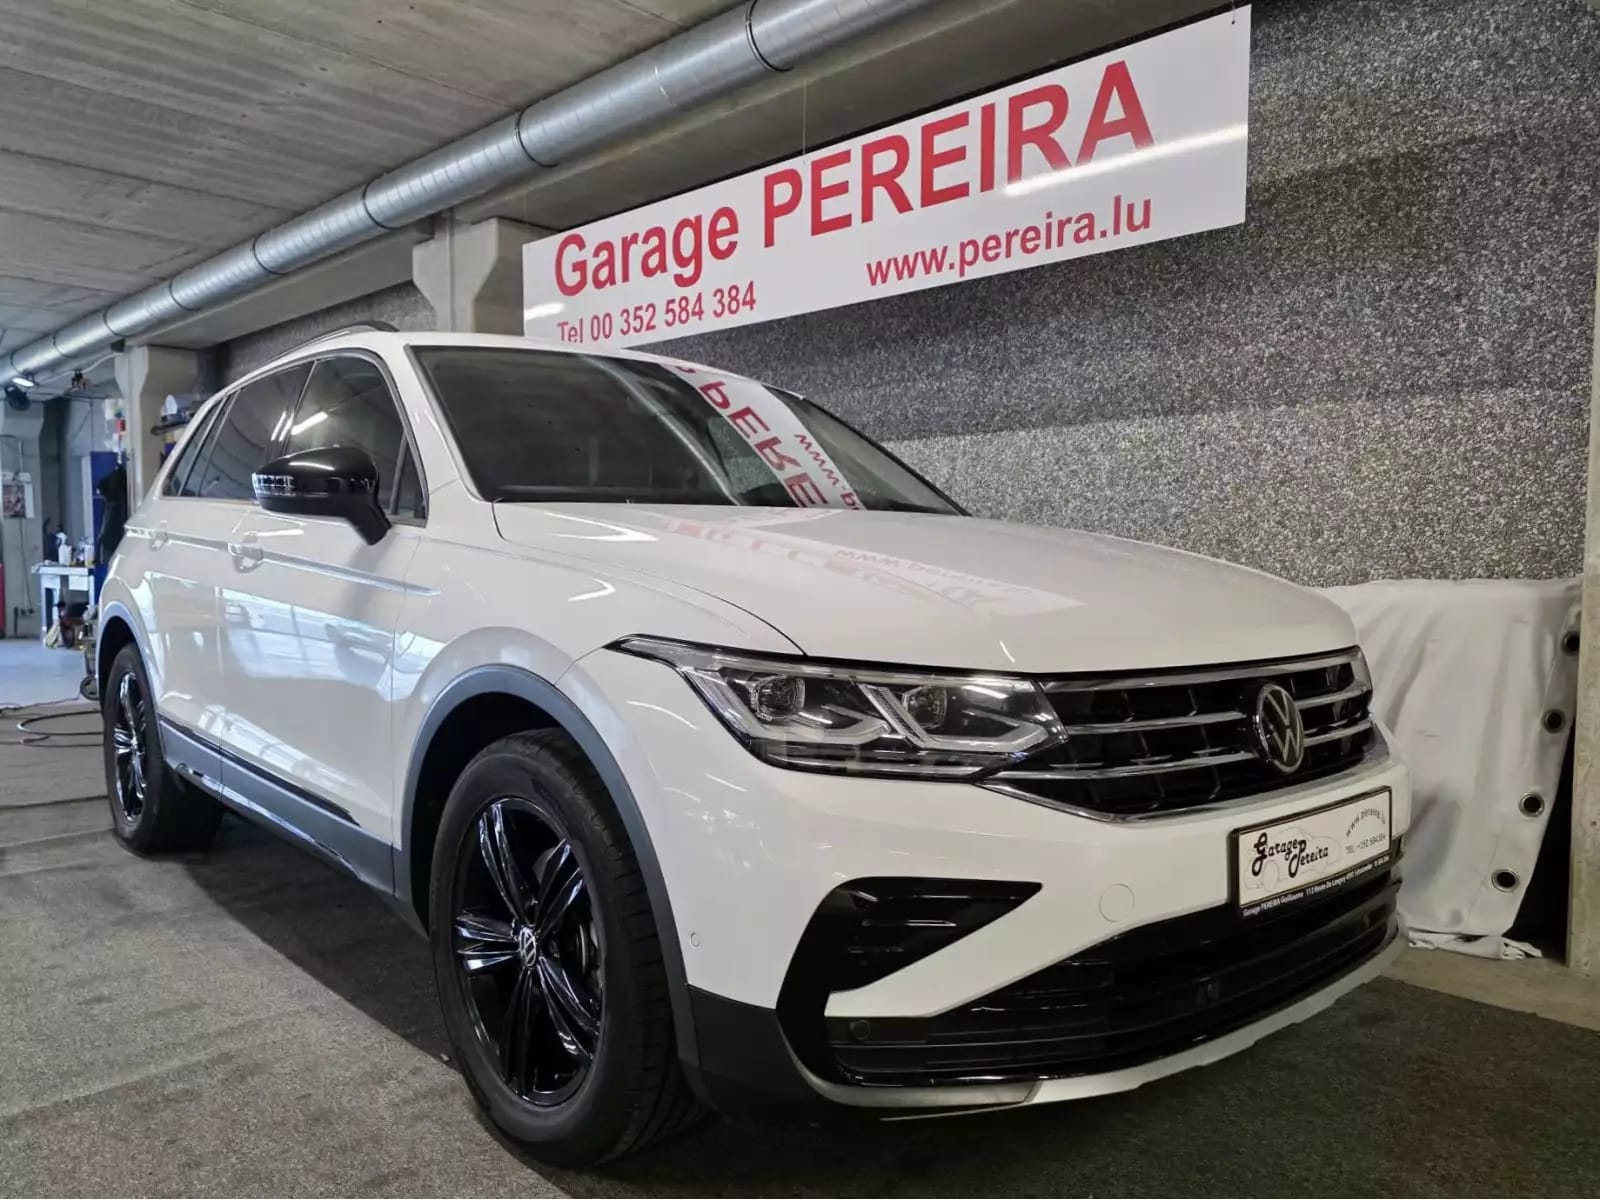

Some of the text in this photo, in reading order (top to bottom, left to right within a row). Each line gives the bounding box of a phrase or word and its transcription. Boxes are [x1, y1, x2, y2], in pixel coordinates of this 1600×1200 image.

[554, 60, 1155, 297] Garage PEREIRA
[866, 195, 1153, 287] www.pereira.lu
[557, 281, 756, 343] Tel 00 352 584 384
[1251, 832, 1298, 877] Garage
[1288, 839, 1329, 878] Pereira
